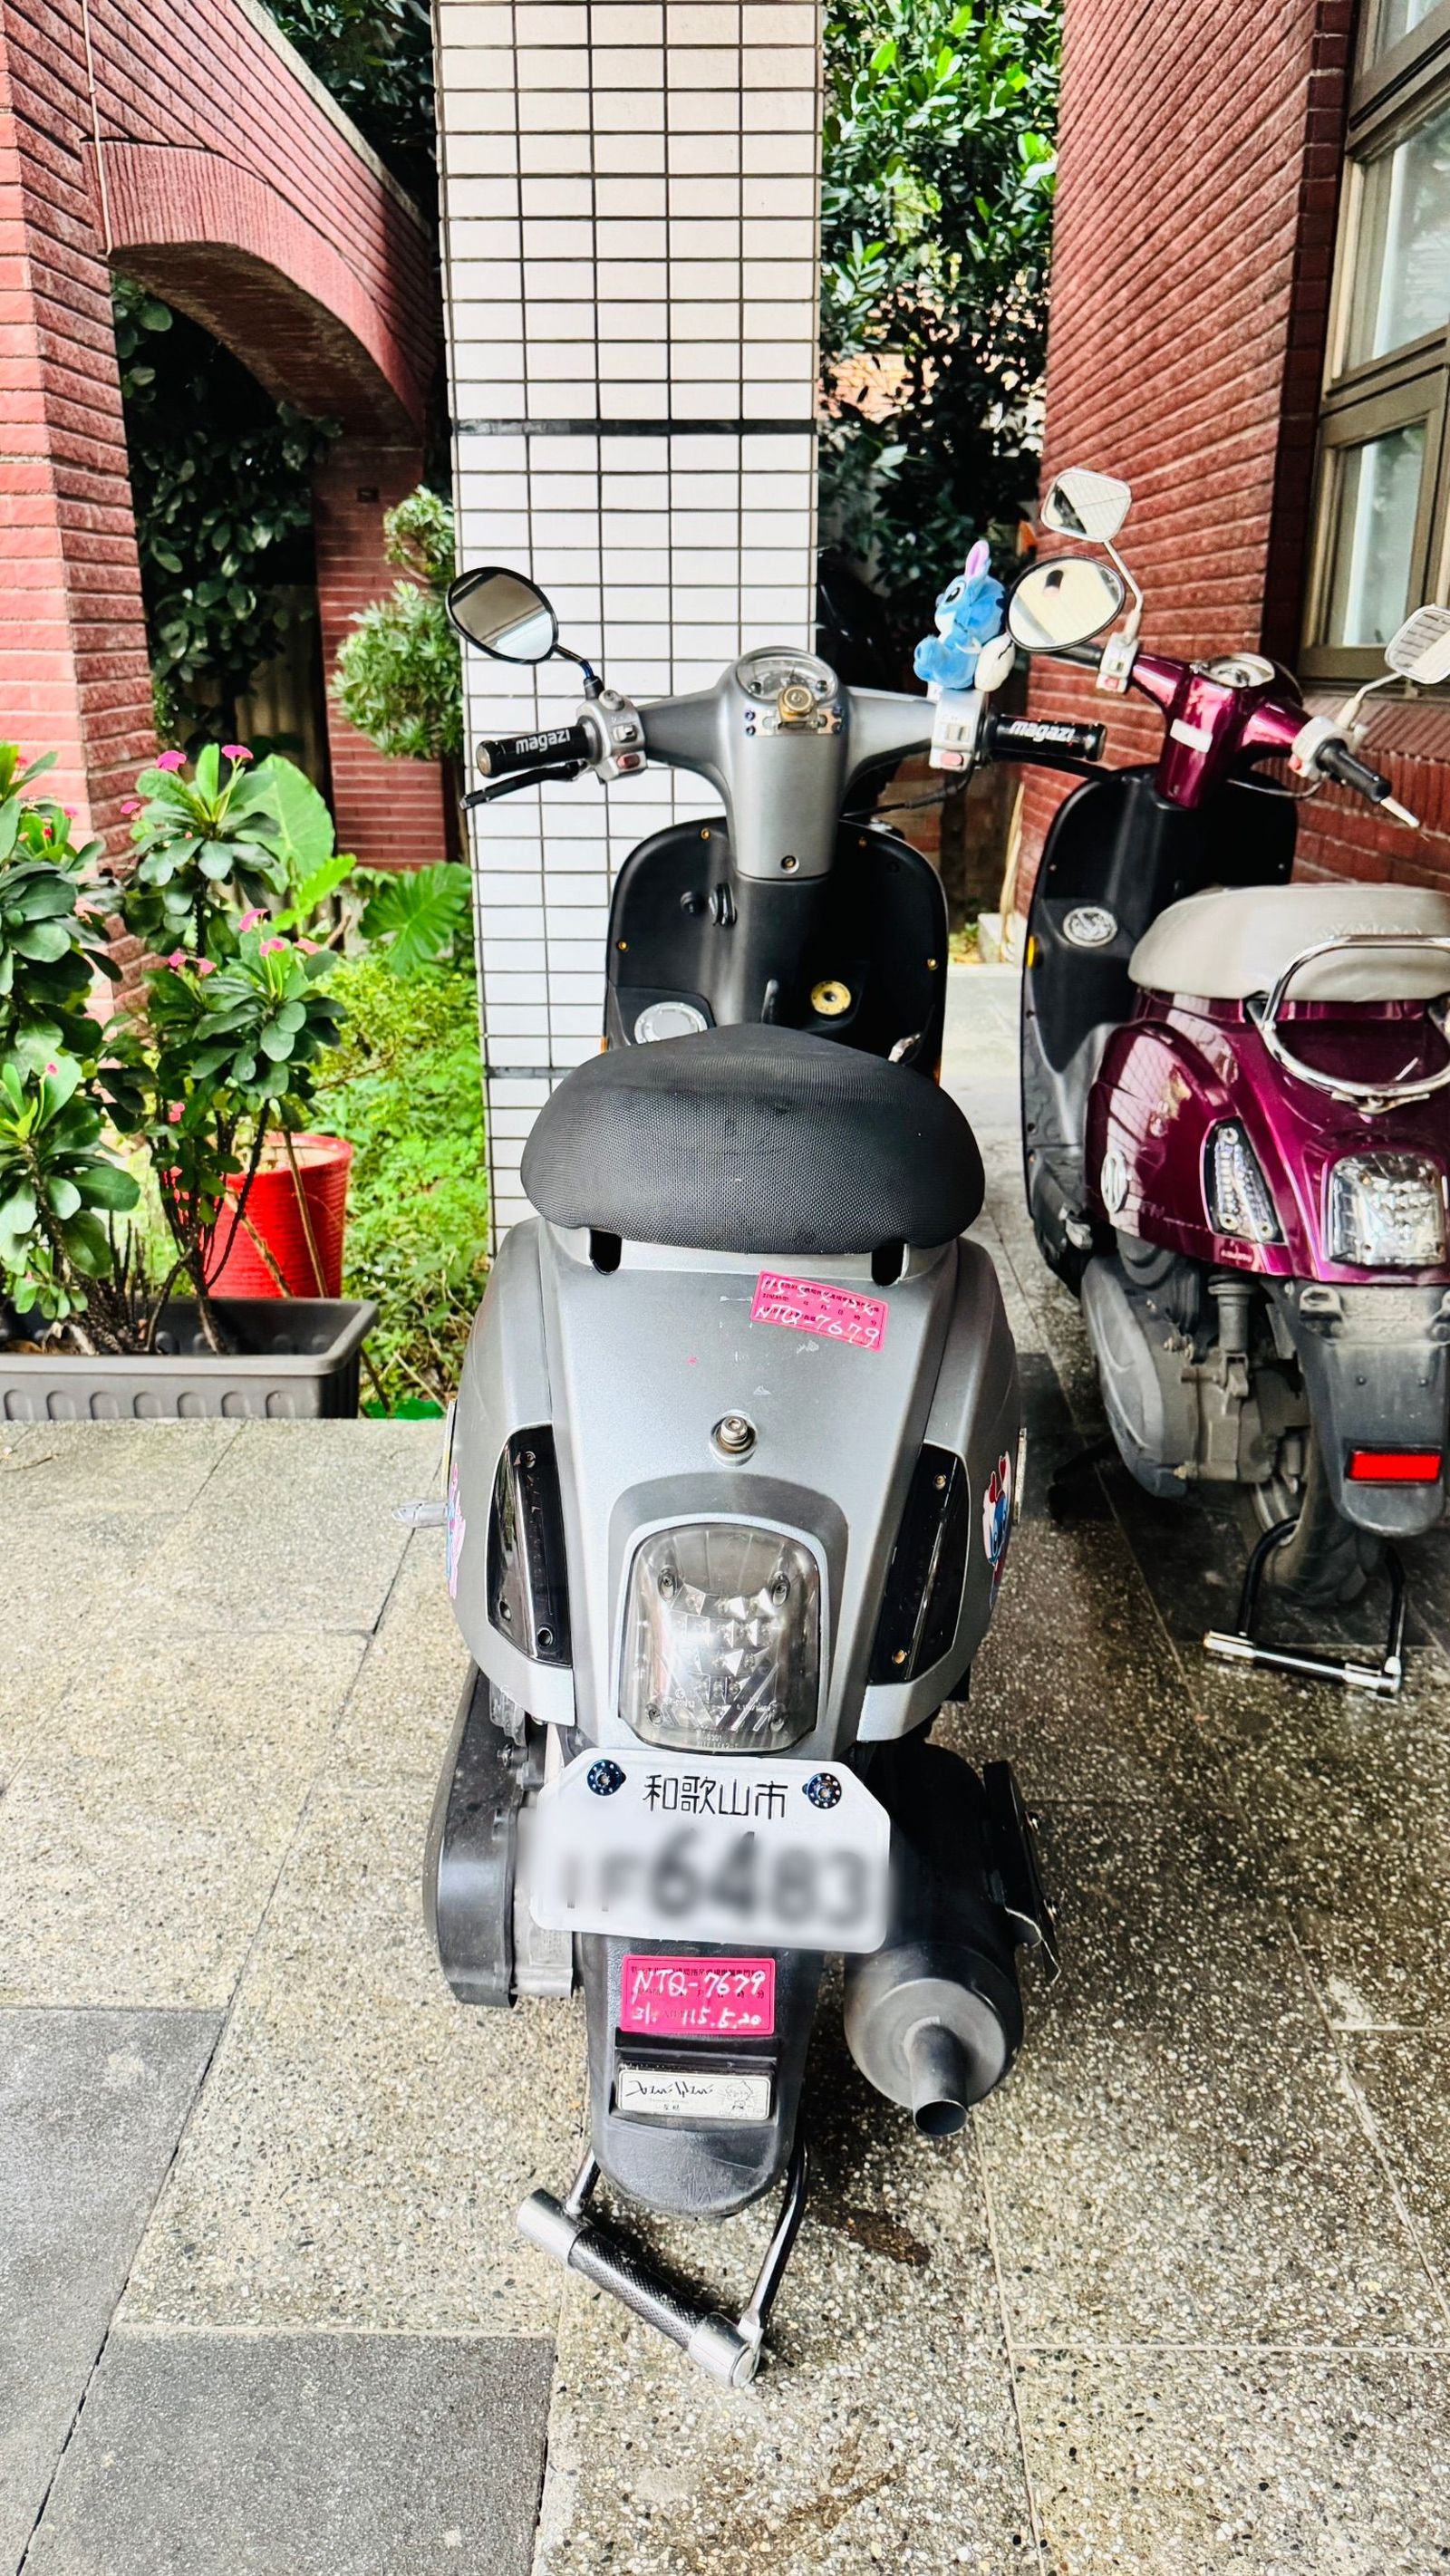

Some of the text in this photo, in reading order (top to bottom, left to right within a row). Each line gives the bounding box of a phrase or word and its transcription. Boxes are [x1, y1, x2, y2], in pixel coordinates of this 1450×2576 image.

[515, 728, 571, 755] magazi
[1009, 720, 1076, 743] magazi
[642, 1773, 788, 1820] 和歌山市
[631, 1969, 766, 2005] NTQ-7679
